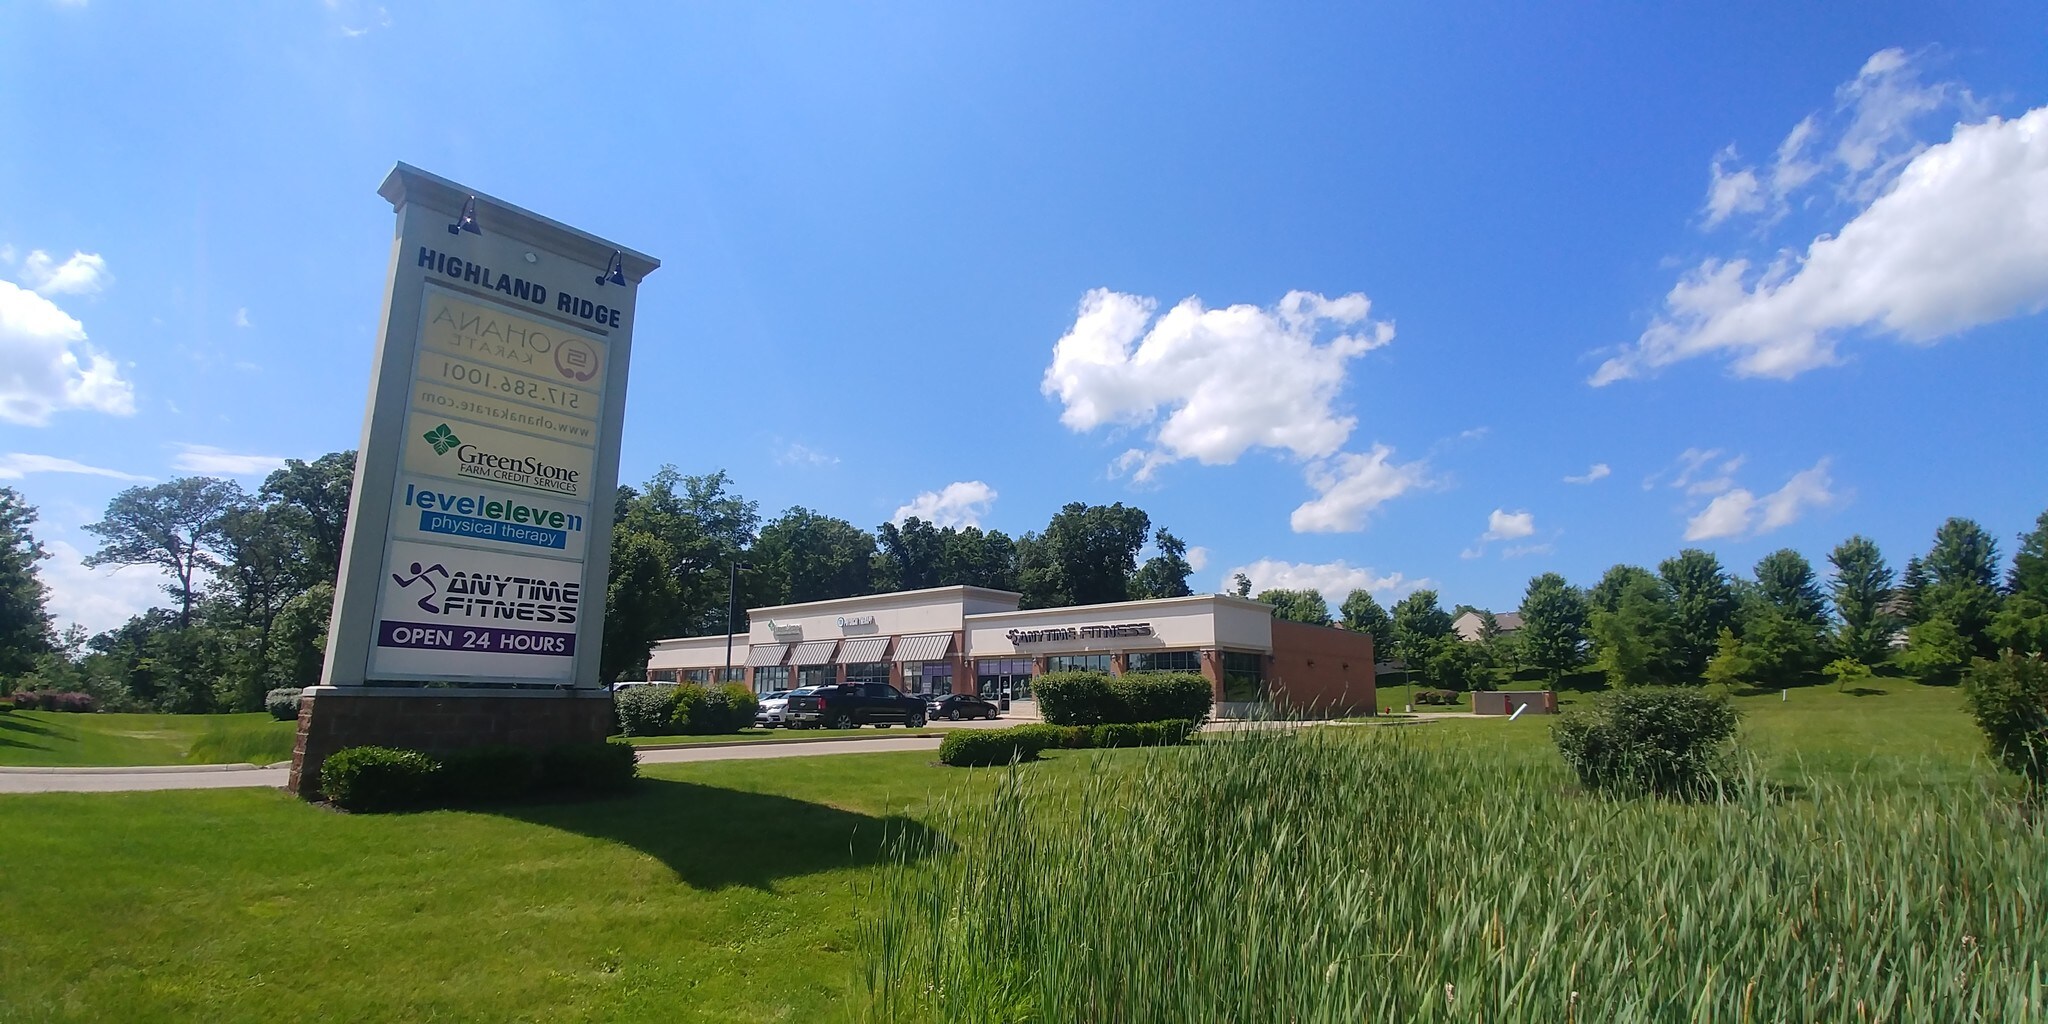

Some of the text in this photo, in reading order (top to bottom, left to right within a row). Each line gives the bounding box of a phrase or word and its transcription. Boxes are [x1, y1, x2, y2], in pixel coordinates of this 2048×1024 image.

[417, 246, 621, 329] HIGHLAND RIDGE
[457, 444, 579, 483] GreenStone
[460, 463, 577, 492] FARM CREDIT SERVICES
[431, 515, 557, 546] physical therapy
[447, 571, 580, 604] ANYTIME
[443, 596, 577, 624] FITNESS
[392, 627, 565, 652] OPEN 24 HOURS
[1018, 622, 1151, 644] ANYTIME FITNESS
